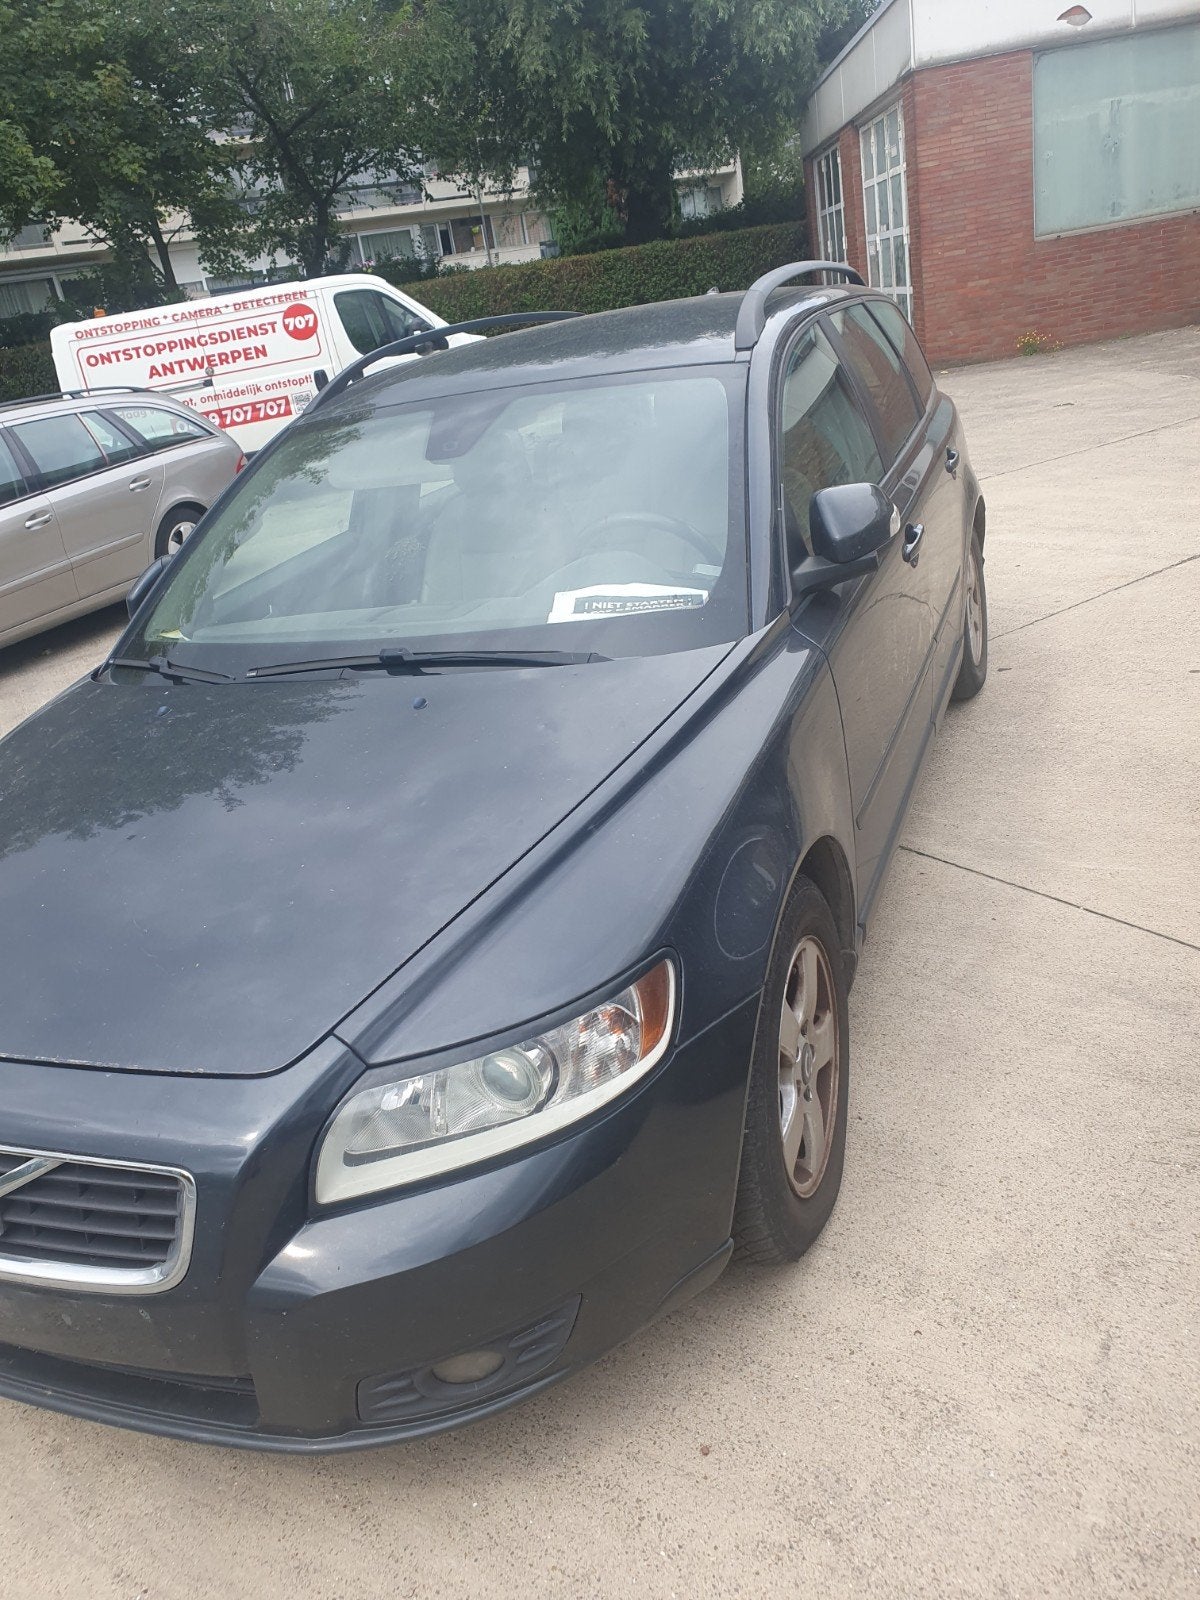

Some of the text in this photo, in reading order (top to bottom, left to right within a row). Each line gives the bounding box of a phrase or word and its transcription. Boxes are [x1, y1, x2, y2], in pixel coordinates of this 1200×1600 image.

[75, 290, 308, 339] ONTSTOPPING CAMERA DETECTEREN
[284, 313, 315, 331] 707
[85, 321, 277, 367] ONTSTOPPINGSDIENST
[148, 344, 268, 379] ANTWERPEN
[200, 383, 263, 404] onmiddelijk
[265, 374, 313, 392] ontstopt!
[222, 406, 253, 425] 707
[256, 399, 286, 417] 707
[592, 601, 623, 609] NIET
